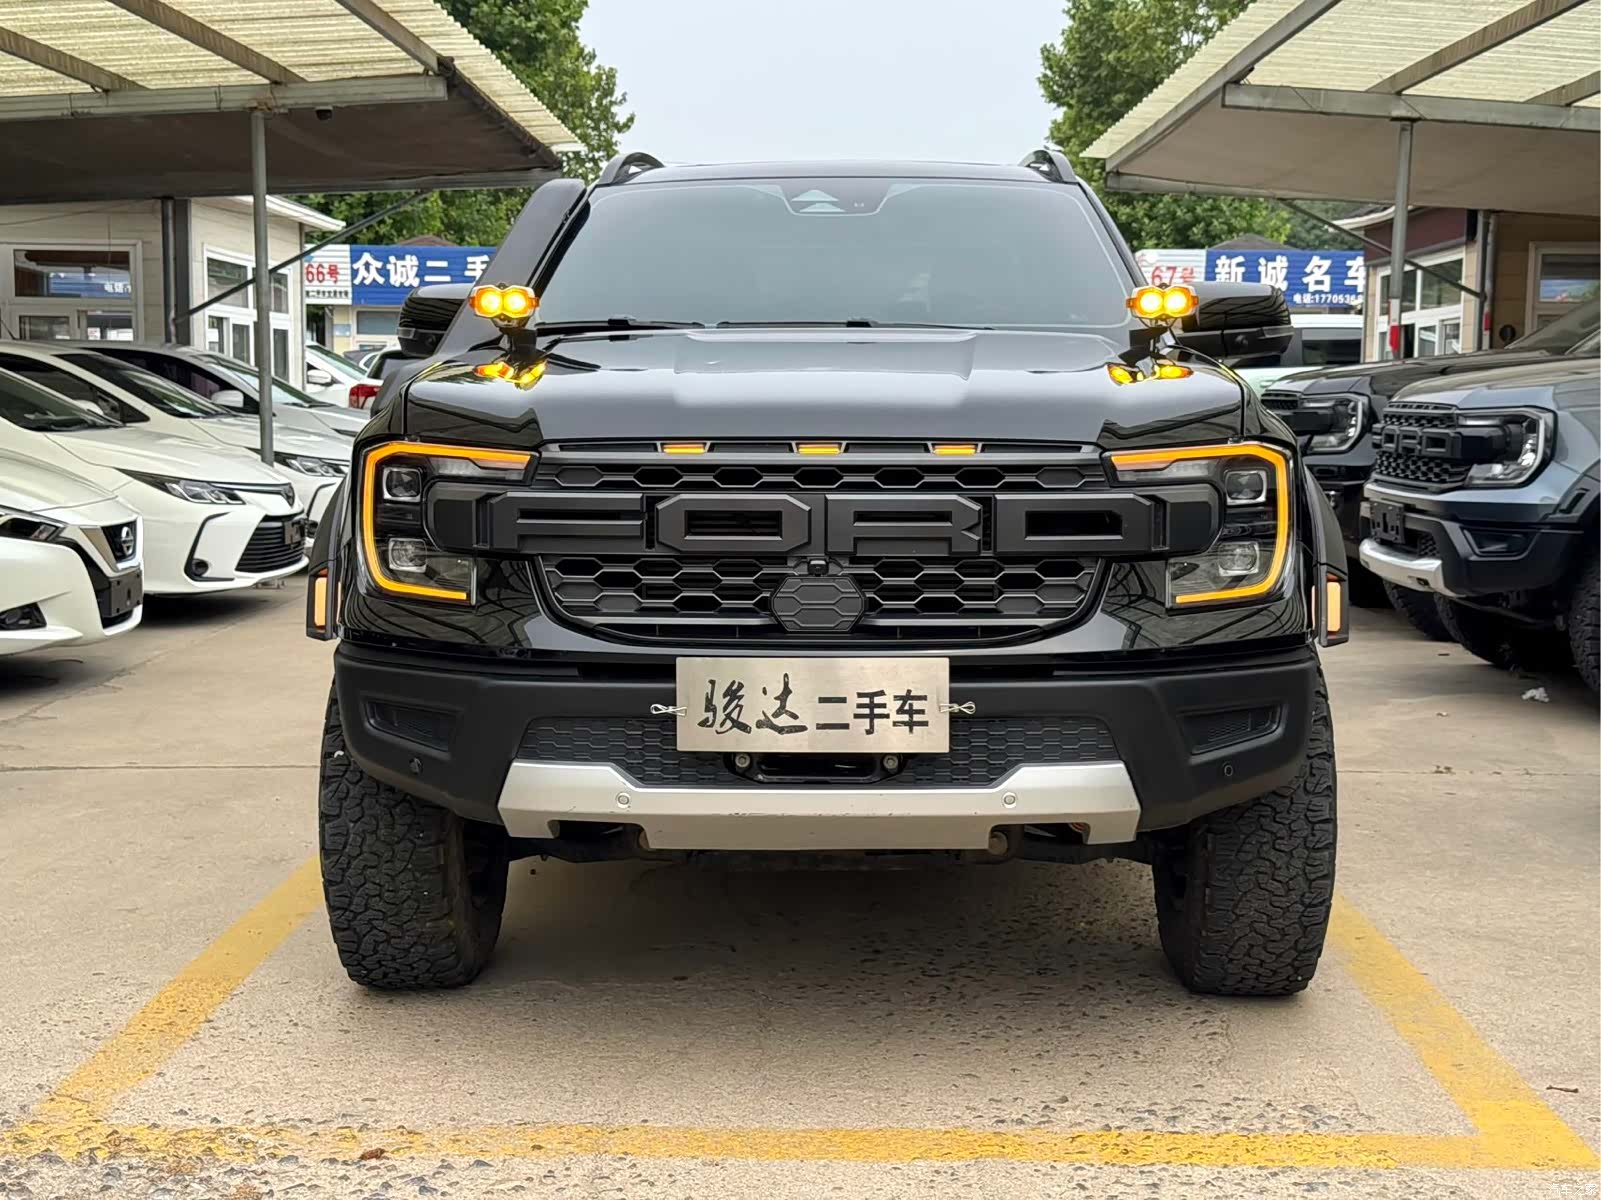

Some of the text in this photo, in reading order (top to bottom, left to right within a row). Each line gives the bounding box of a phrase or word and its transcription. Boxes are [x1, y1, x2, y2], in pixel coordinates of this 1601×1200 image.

[305, 263, 340, 284] 66号
[490, 491, 1152, 556] FORD
[697, 672, 929, 735] 骏达二手车
